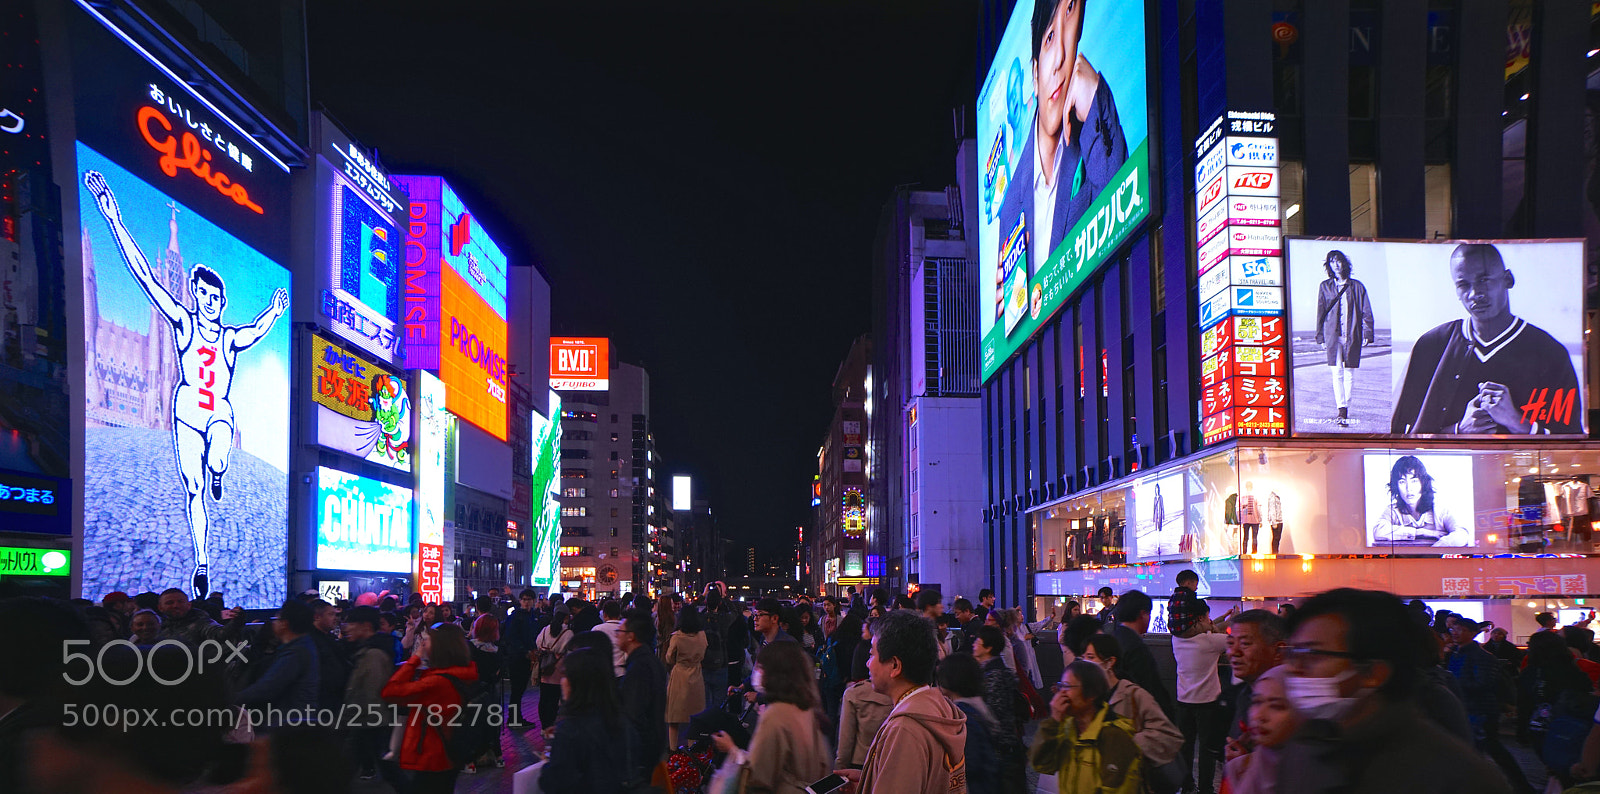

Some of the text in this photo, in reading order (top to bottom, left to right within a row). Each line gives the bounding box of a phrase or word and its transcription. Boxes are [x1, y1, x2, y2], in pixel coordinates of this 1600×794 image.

[138, 106, 264, 214] Glico
[1236, 173, 1272, 189] TKP
[1074, 166, 1141, 273] サロンパス
[451, 316, 506, 386] PROMISE
[1238, 325, 1261, 339] 5F
[196, 346, 218, 412] グリコ
[324, 345, 366, 380] かぜに
[558, 349, 593, 372] B.V.D.
[1262, 317, 1284, 423] インターネット
[317, 365, 370, 412] 改源
[562, 381, 596, 389] FUJIBO
[1520, 387, 1576, 425] H&M
[0, 484, 55, 504] あつまる
